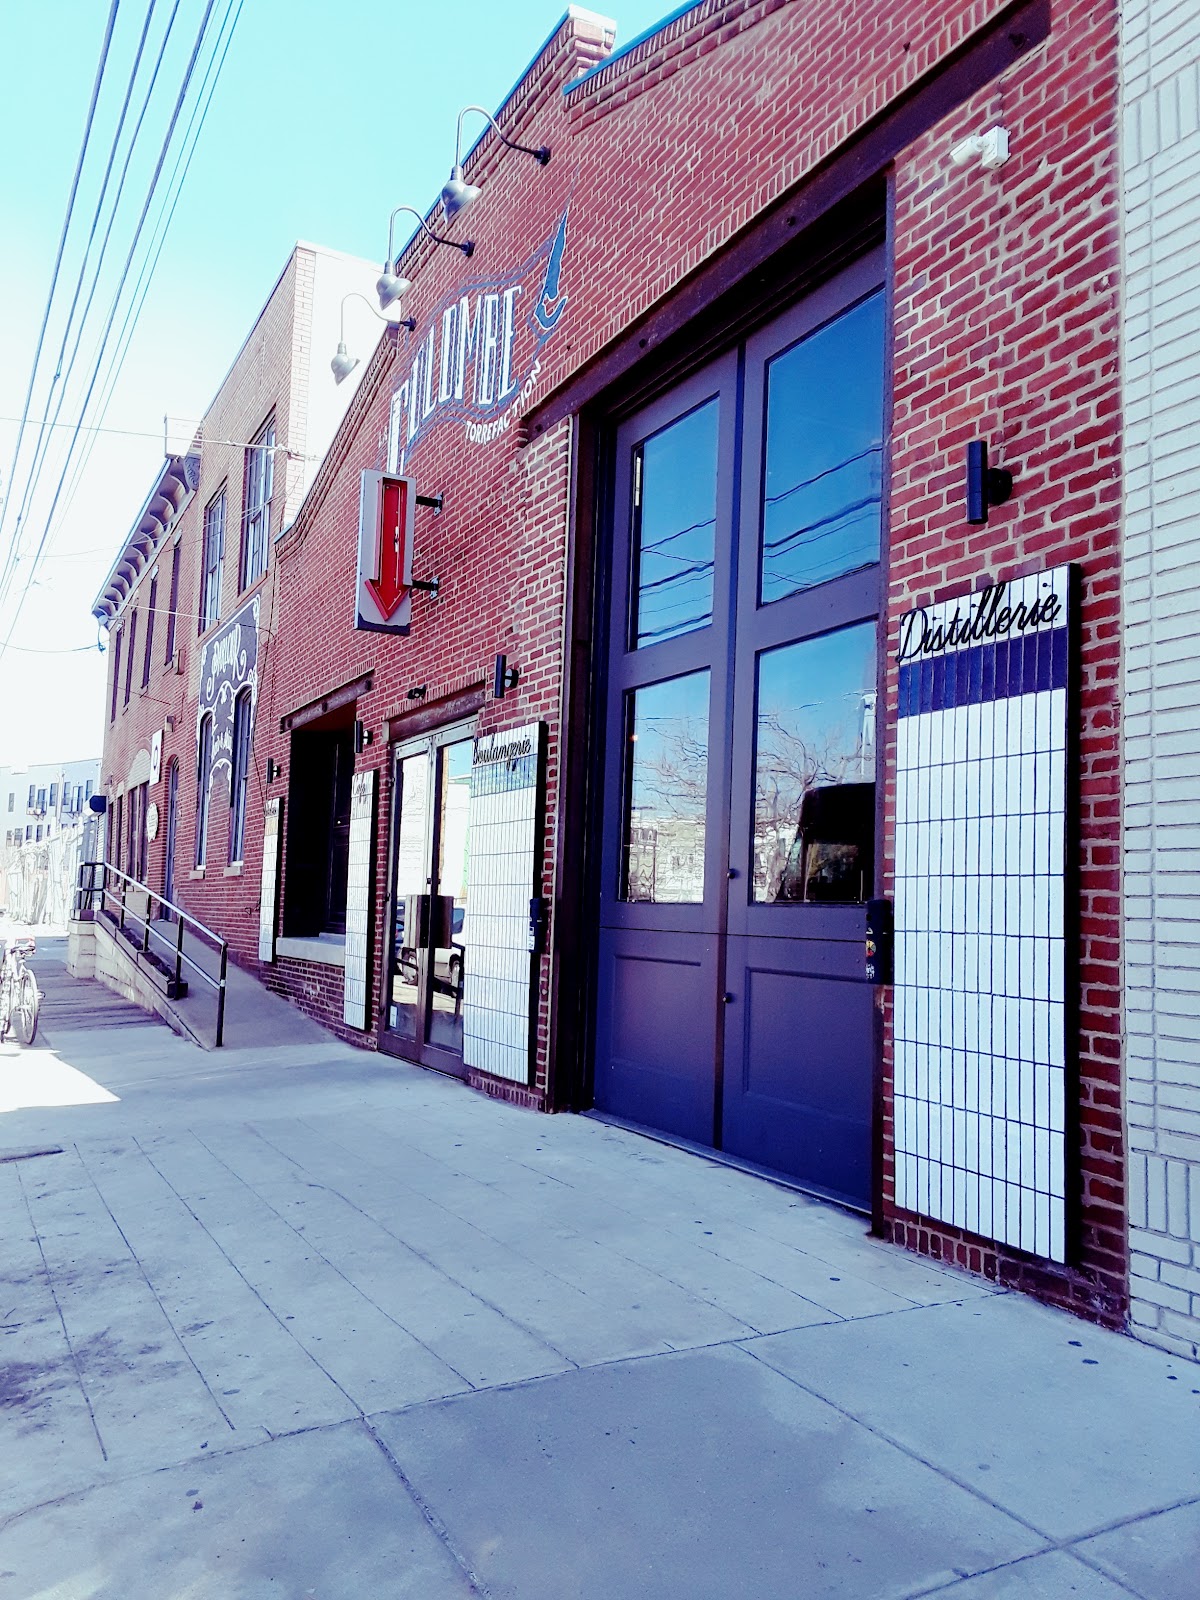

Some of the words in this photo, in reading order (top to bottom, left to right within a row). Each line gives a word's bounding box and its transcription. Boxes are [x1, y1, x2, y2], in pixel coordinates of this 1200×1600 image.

[465, 360, 542, 444] TORREFACTION
[895, 581, 1062, 663] Distillerie
[473, 733, 531, 771] Boulangerie
